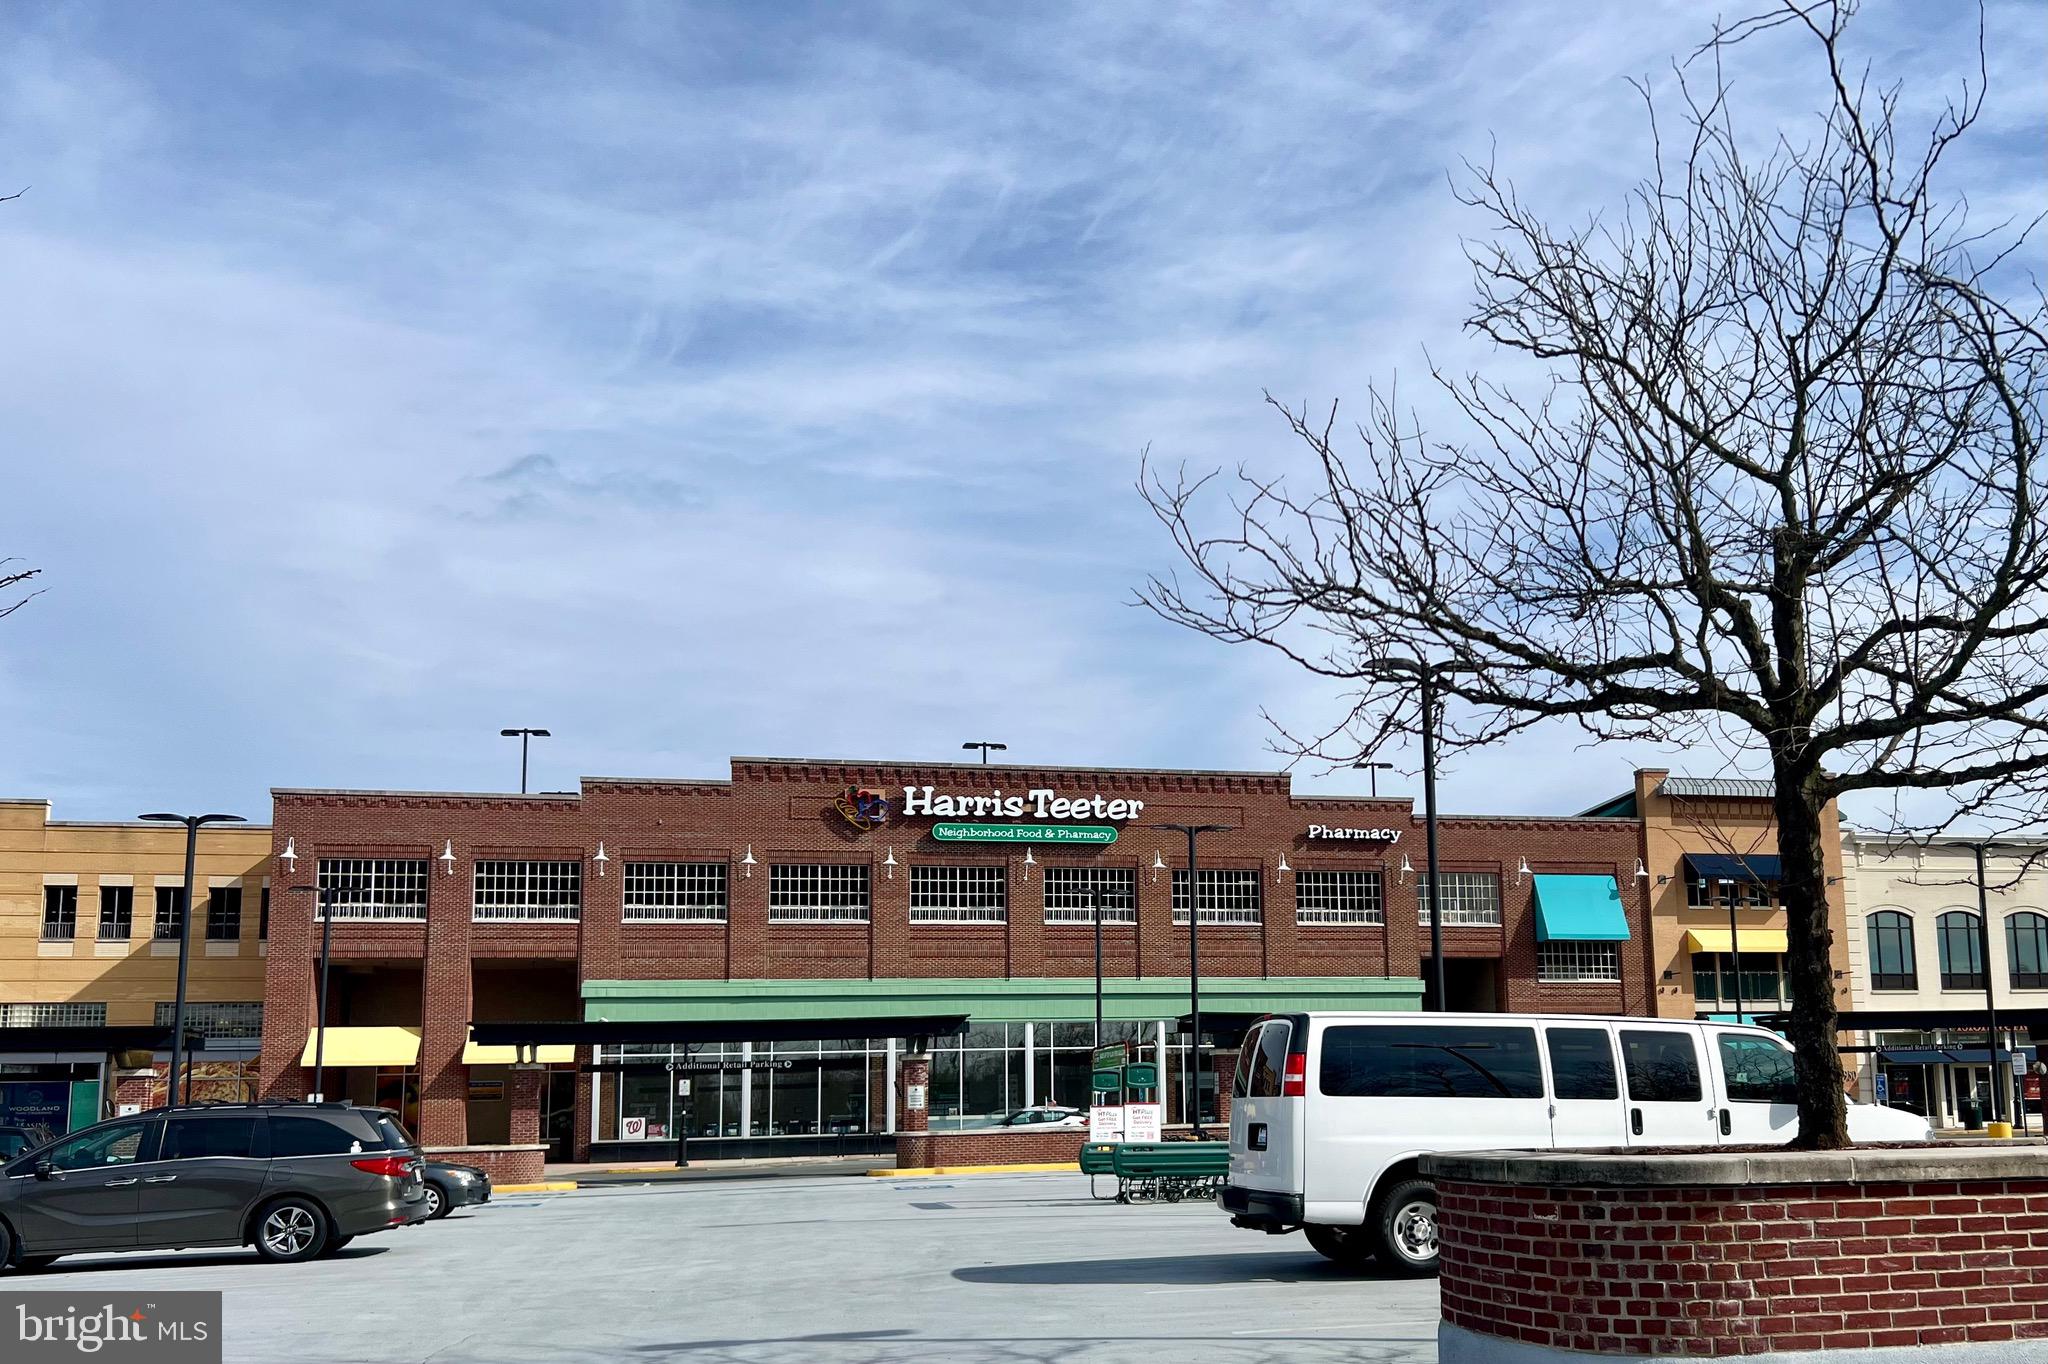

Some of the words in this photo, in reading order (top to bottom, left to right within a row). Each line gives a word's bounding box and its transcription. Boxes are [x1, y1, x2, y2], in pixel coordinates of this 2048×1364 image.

[903, 785, 1024, 817] Harris
[1028, 788, 1144, 820] Teeter
[938, 827, 1014, 839] Neighborhood
[1016, 829, 1042, 839] Food
[1044, 829, 1055, 839] &
[1057, 829, 1111, 841] Pharmacy
[1308, 824, 1402, 843] Pharmacy
[1933, 1043, 1956, 1051] Parking
[675, 1061, 720, 1070] Additional
[722, 1060, 747, 1069] Retail
[750, 1060, 783, 1069] Parking
